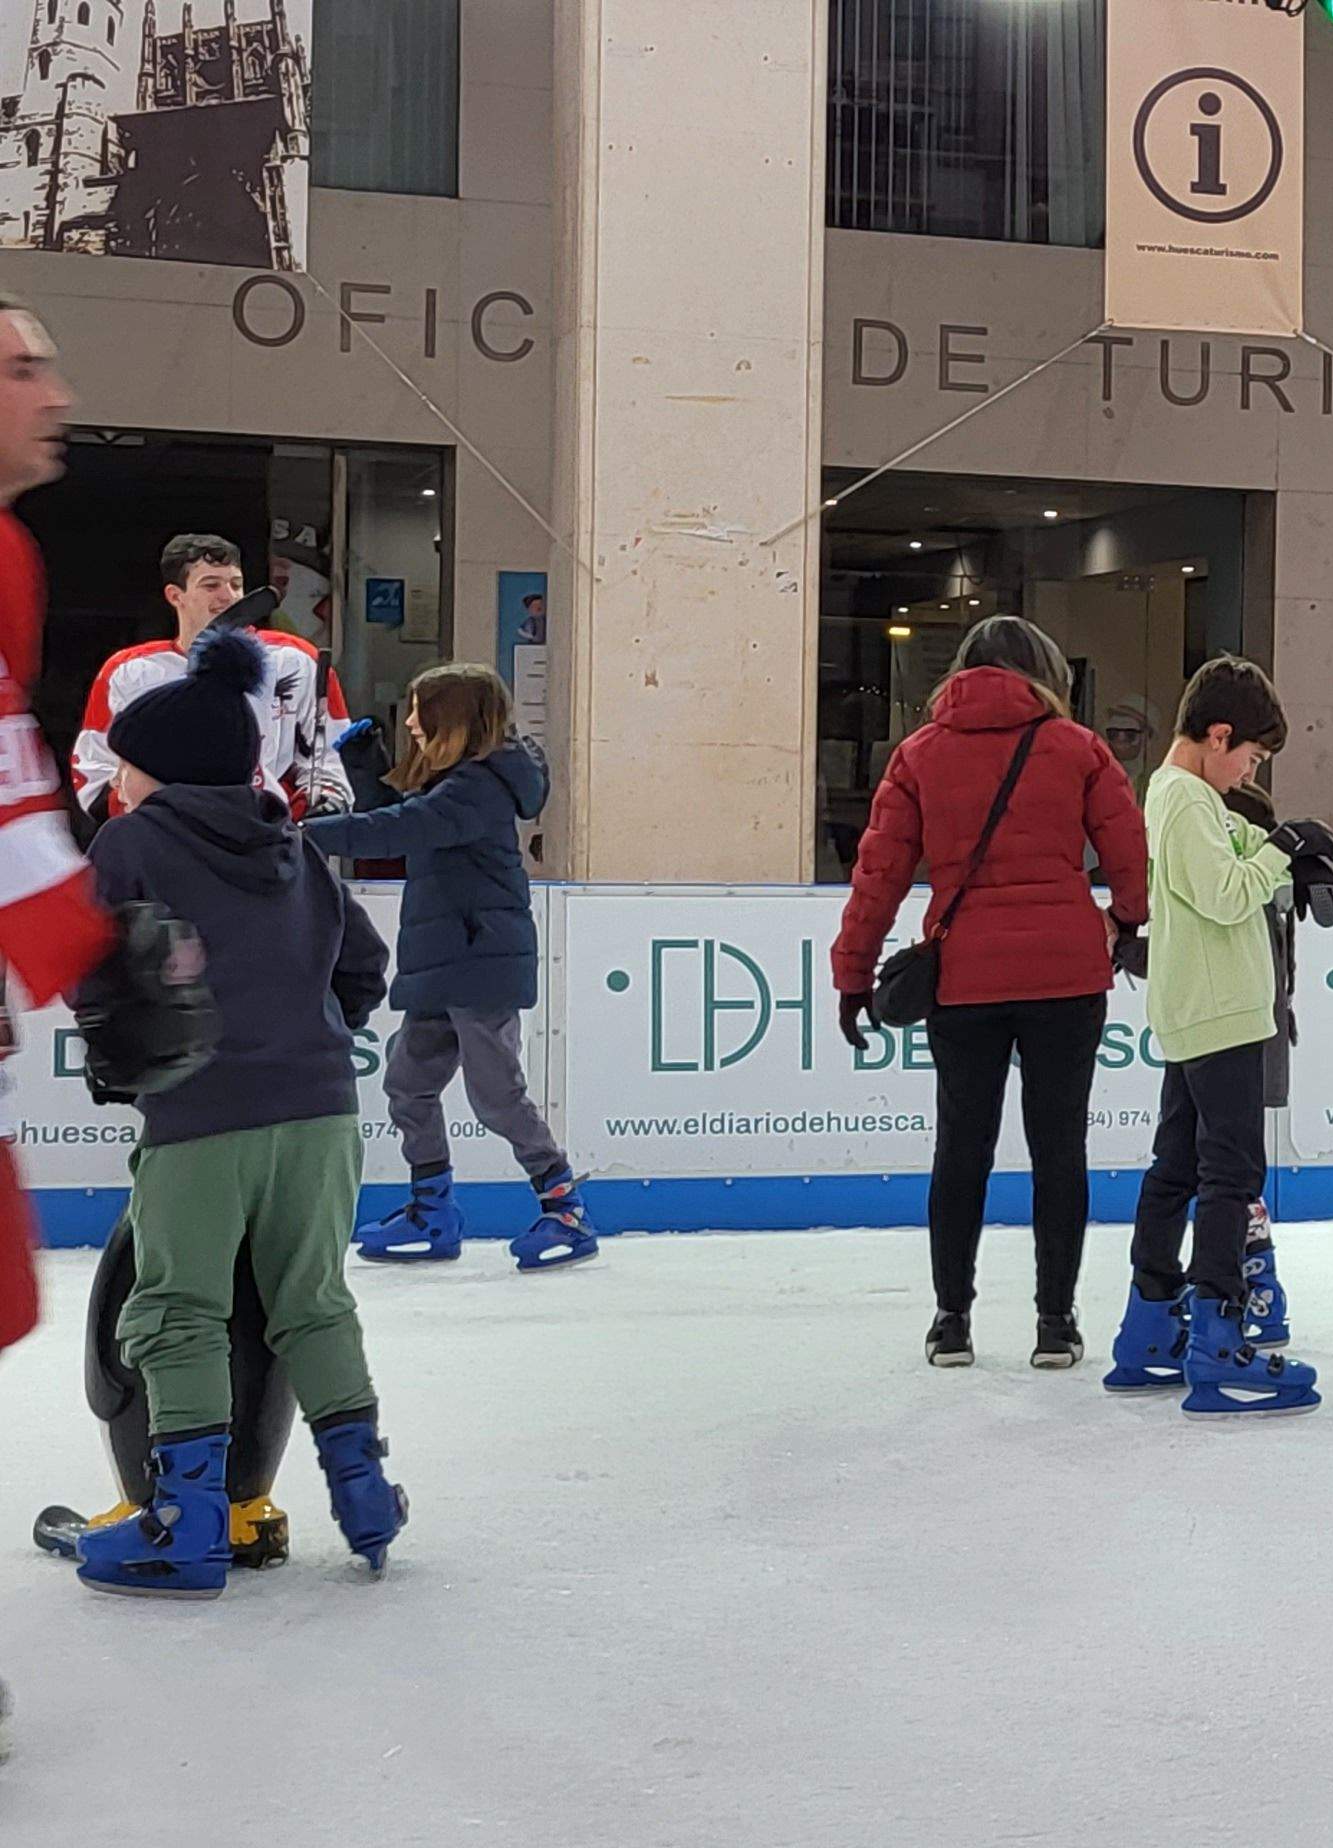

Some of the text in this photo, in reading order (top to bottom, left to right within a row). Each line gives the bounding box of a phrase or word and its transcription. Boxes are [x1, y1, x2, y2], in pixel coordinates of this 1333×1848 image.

[1136, 243, 1280, 261] www.huescaturismo.com
[232, 274, 535, 363] OFIC
[851, 317, 989, 394] DE
[1119, 1110, 1151, 1126] 974
